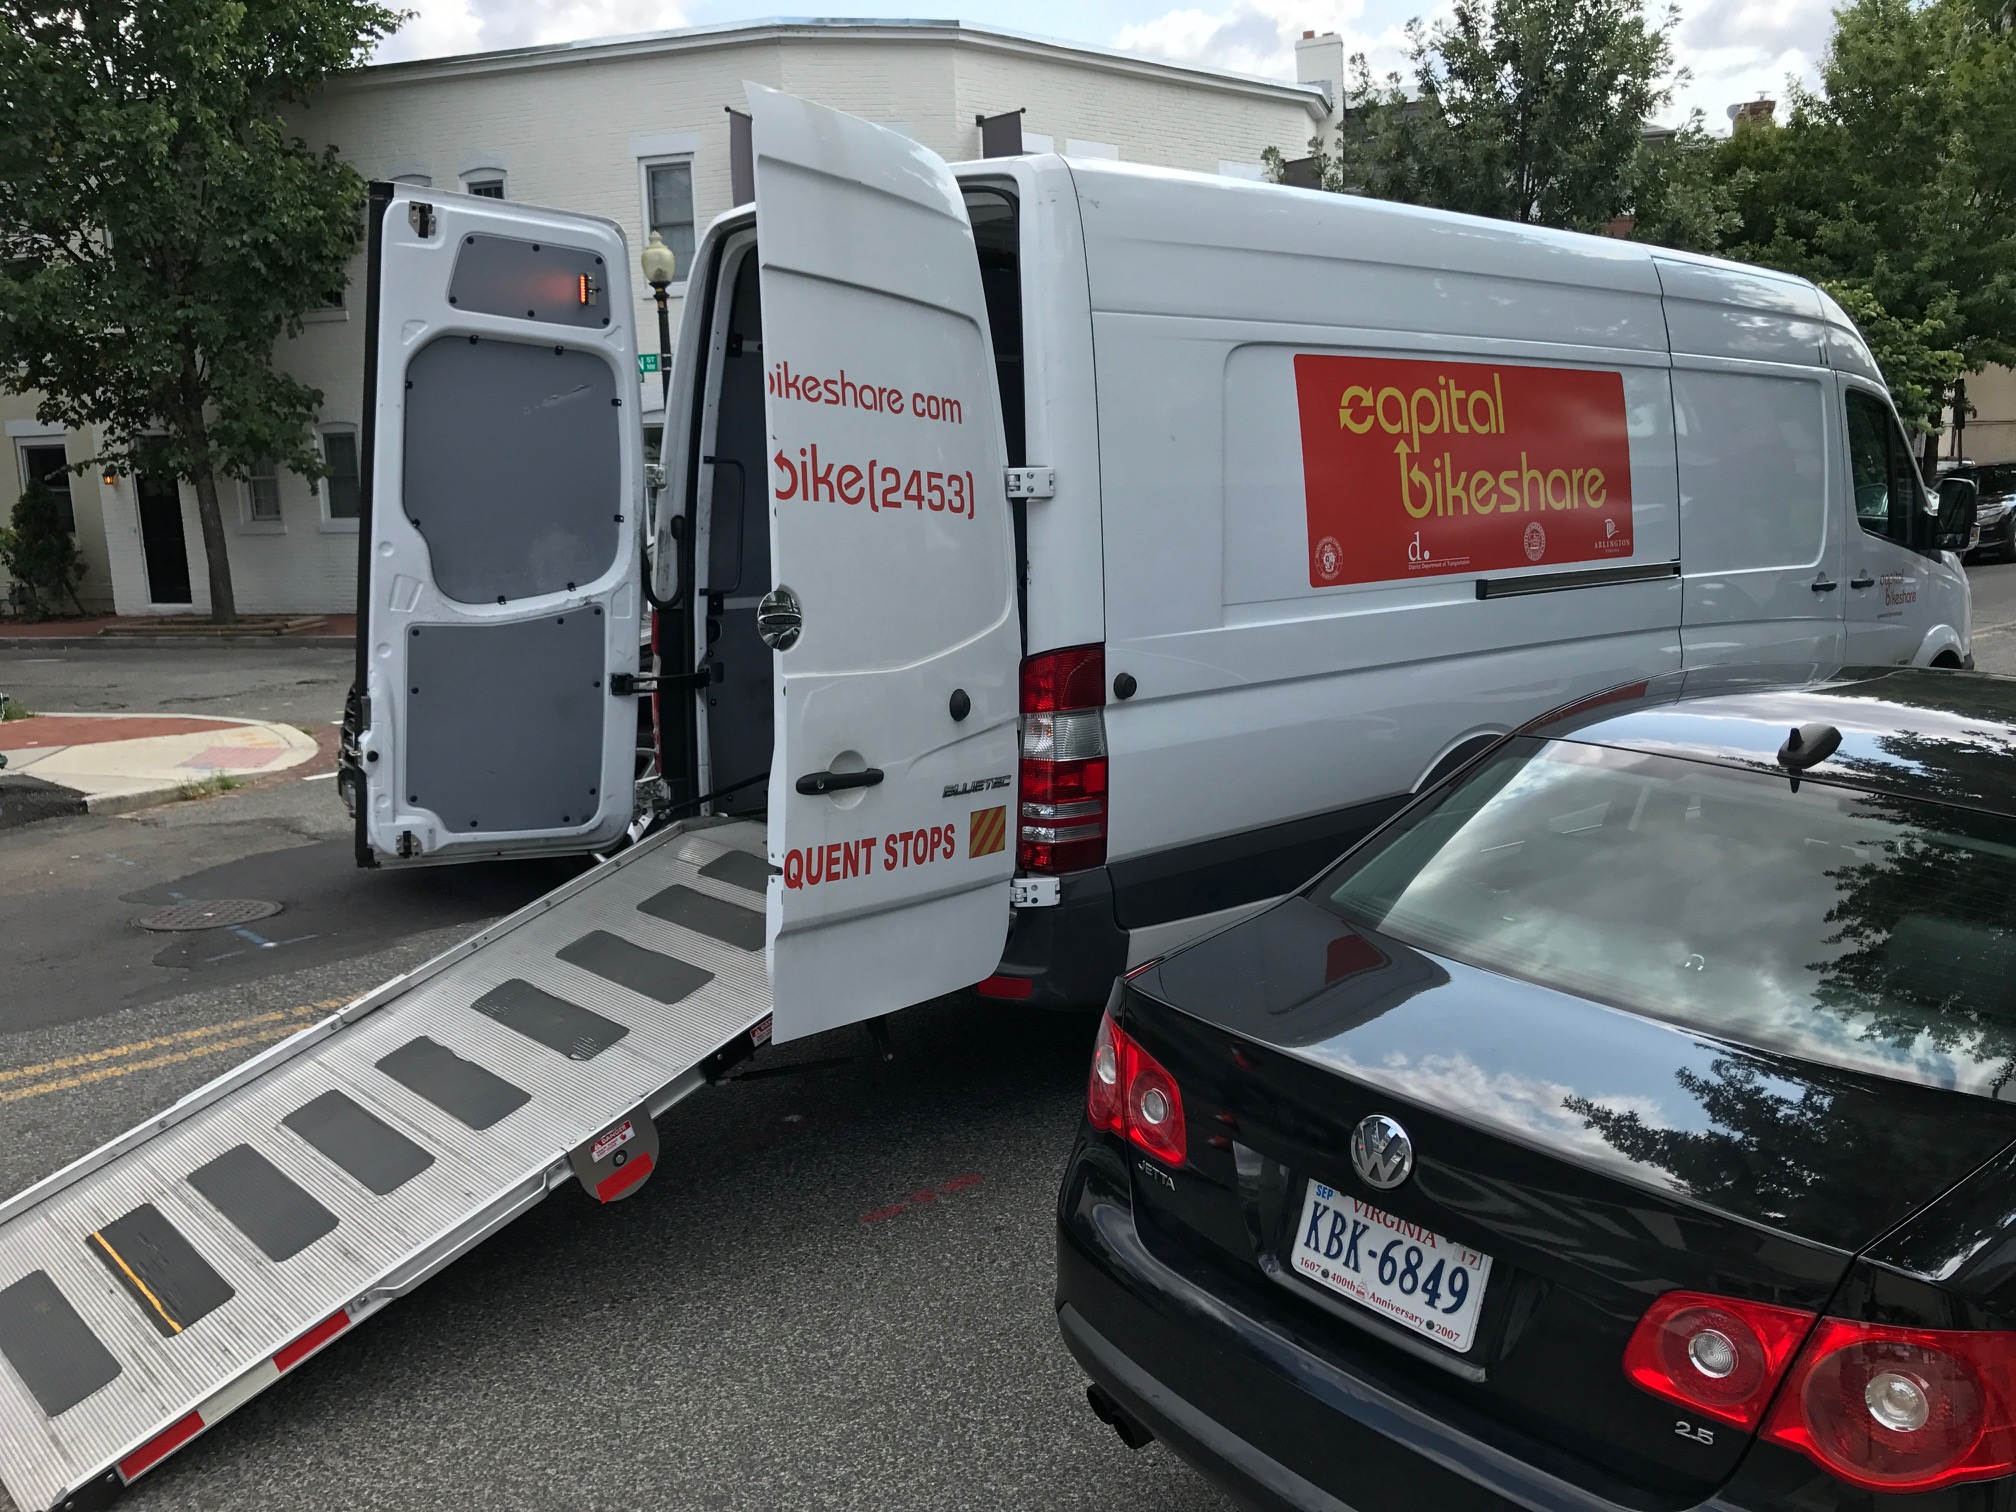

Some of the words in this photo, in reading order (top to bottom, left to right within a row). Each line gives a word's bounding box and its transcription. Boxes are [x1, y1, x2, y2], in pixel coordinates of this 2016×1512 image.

[912, 392, 962, 424] com
[1339, 373, 1505, 453] capital
[1394, 439, 1607, 519] bikeshare
[1594, 539, 1630, 549] ARLINGTON
[1879, 568, 1904, 588] capital
[1886, 588, 1917, 606] bikeshare
[942, 775, 1012, 798] BLUETEC
[784, 837, 877, 890] QUENT
[883, 823, 955, 871] STOPS
[601, 1124, 627, 1144] DANGER
[1138, 1160, 1176, 1191] JETTA
[1316, 1184, 1334, 1200] SEP
[1353, 1199, 1437, 1249] VIRGINIA
[1304, 1201, 1470, 1314] KBK-6849
[1461, 1251, 1477, 1266] 17
[1300, 1257, 1322, 1273] 1607
[1330, 1273, 1356, 1292] 400th
[1368, 1291, 1425, 1328] Anniversary
[1435, 1323, 1461, 1342] 2007
